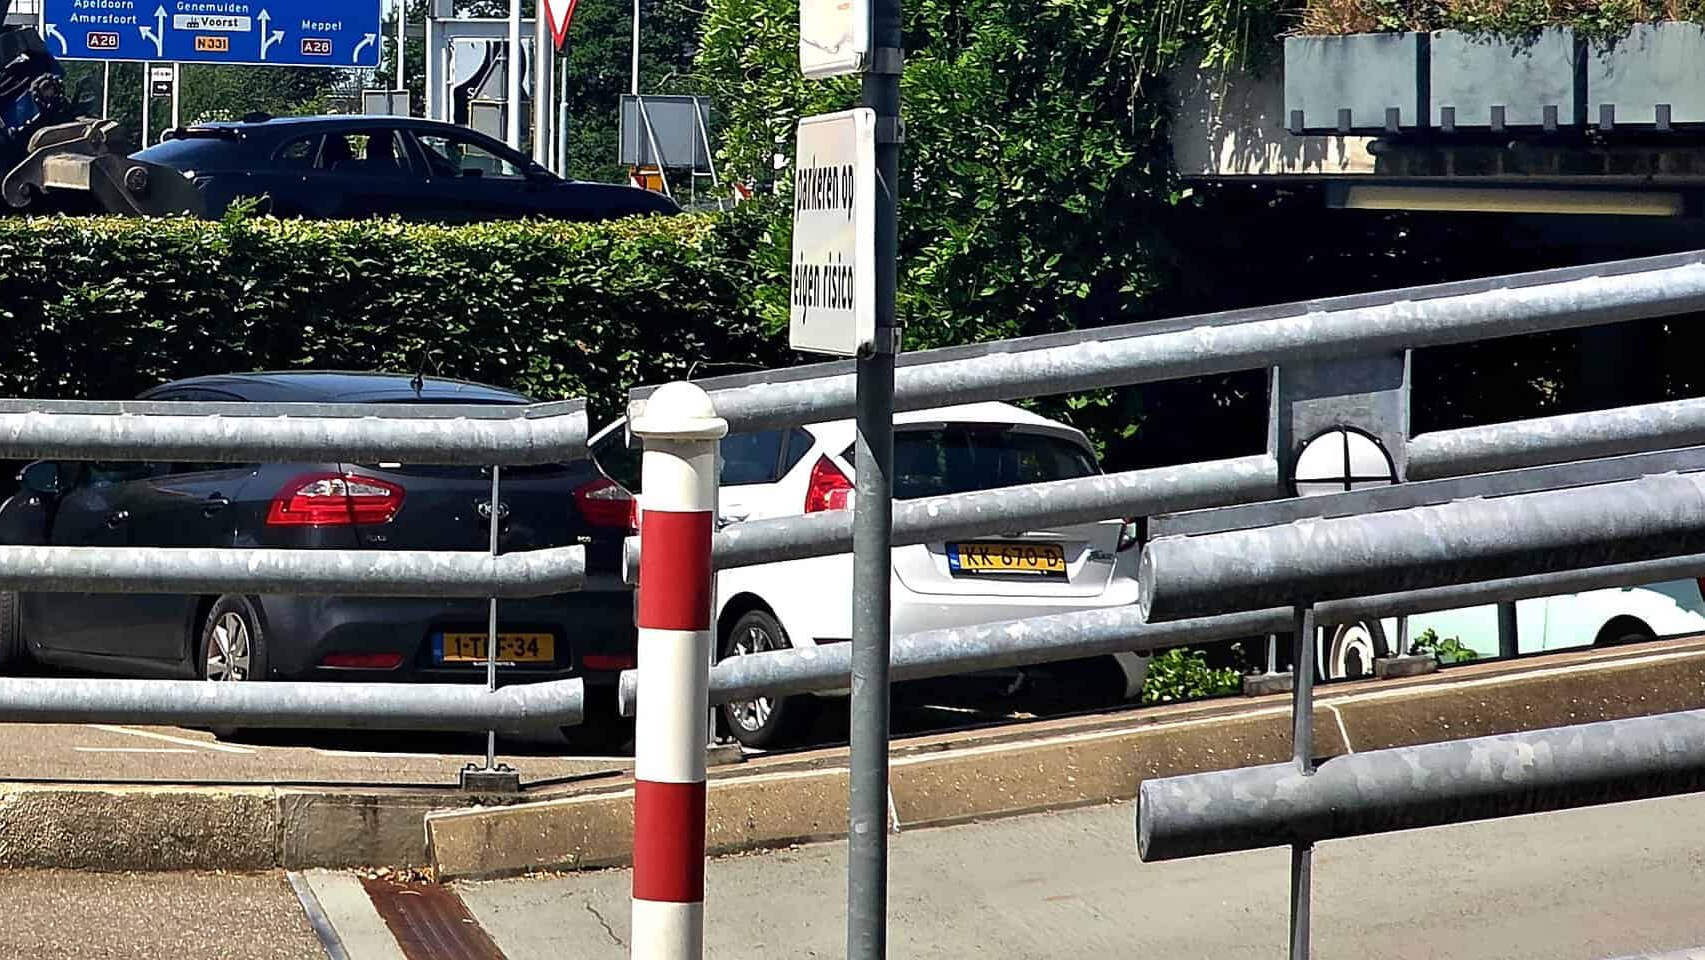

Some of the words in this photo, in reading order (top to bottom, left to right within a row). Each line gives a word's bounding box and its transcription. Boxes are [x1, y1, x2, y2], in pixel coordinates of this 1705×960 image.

[70, 12, 137, 24] Amersfoort
[201, 17, 239, 27] Voorst
[301, 19, 342, 32] Meppel
[90, 35, 116, 46] A28
[304, 42, 329, 52] A28
[797, 154, 839, 220] parkeren
[841, 163, 853, 221] op
[794, 252, 820, 324] eigen
[823, 251, 853, 310] risico
